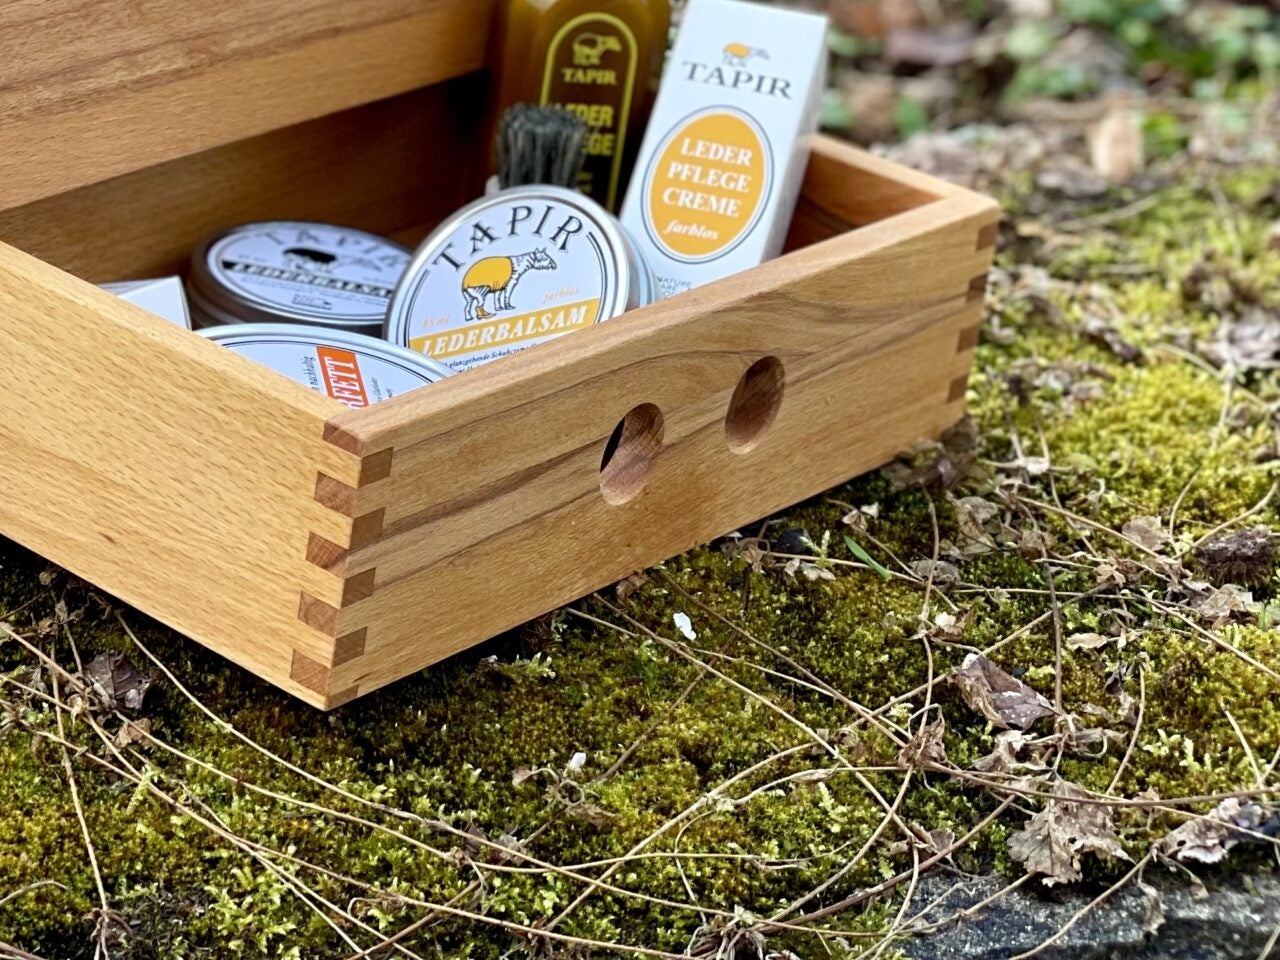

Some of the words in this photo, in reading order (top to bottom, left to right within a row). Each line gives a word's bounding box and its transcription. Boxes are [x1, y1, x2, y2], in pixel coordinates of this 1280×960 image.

[562, 67, 617, 86] TAPIR
[682, 60, 794, 100] TAPIR
[555, 103, 614, 128] DER
[680, 137, 753, 167] LEDER
[667, 161, 752, 193] PFLEGE
[662, 187, 742, 218] CREME
[432, 205, 583, 272] TAPIR
[662, 219, 720, 240] farblos
[232, 263, 393, 297] LEDERBALSA
[422, 305, 589, 357] LEDERBALSAM
